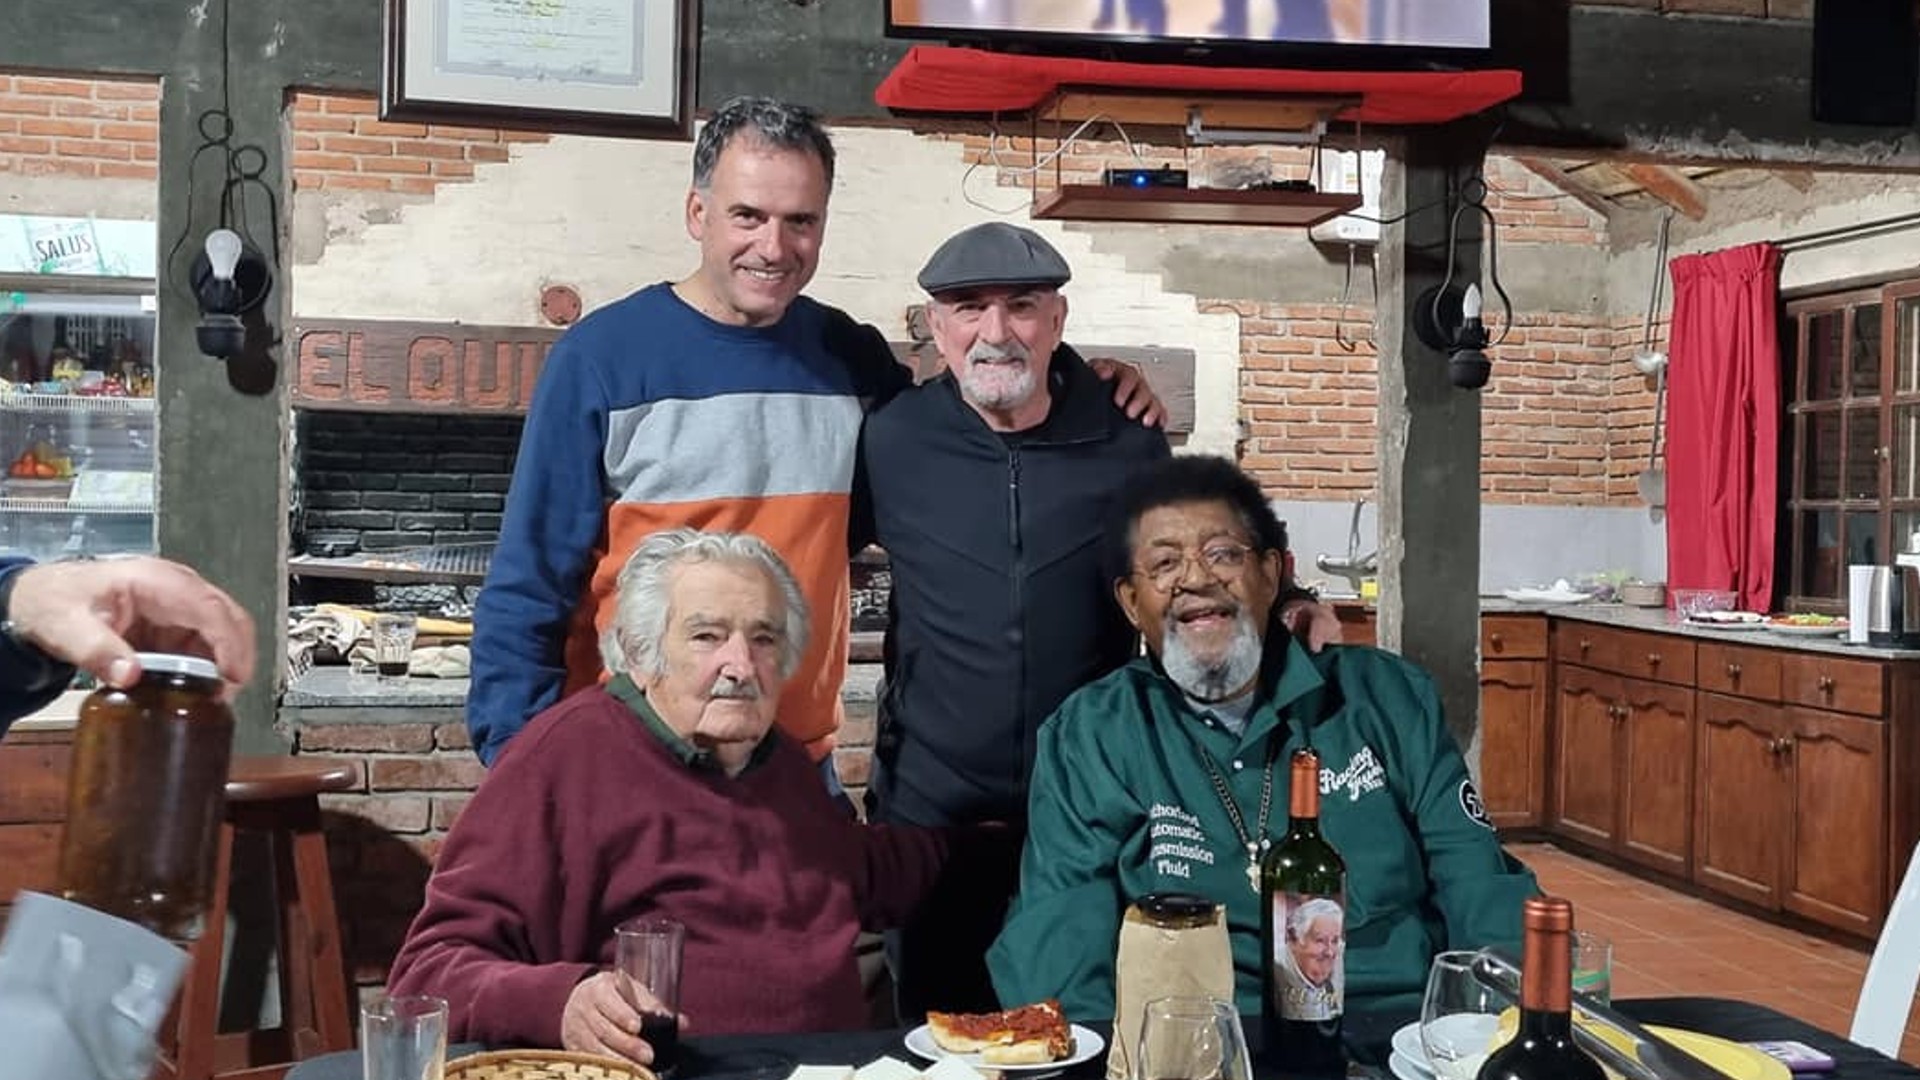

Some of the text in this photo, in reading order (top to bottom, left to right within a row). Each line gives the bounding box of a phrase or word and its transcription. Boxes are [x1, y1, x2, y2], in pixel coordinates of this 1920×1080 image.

[35, 233, 91, 262] SALUS
[299, 330, 556, 410] EL QUI
